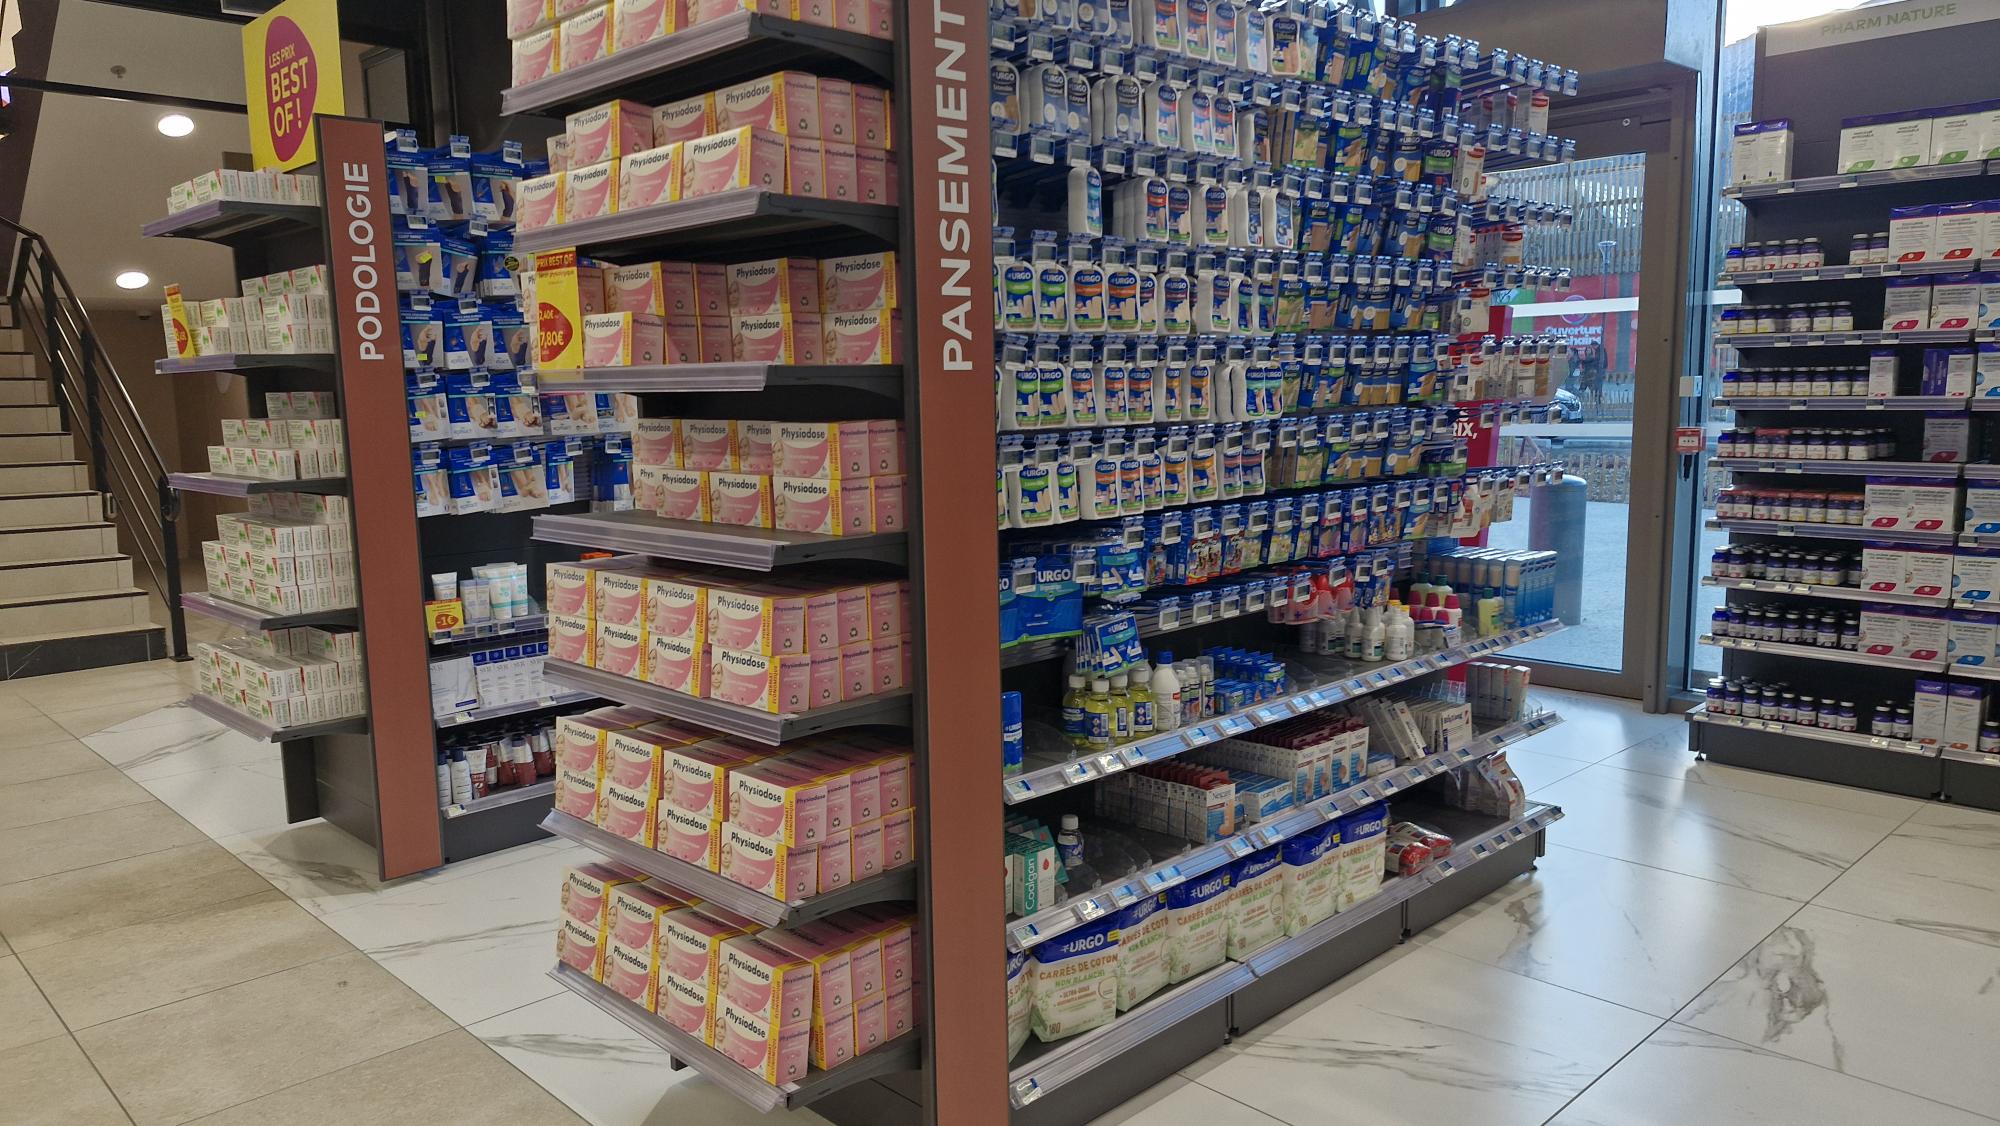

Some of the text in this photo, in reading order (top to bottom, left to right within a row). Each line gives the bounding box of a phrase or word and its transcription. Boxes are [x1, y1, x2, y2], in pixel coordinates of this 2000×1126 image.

[1820, 3, 1959, 36] PHARM NATURE
[269, 43, 296, 68] LES PRIX
[271, 56, 308, 104] BEST
[996, 72, 1015, 81] URGO
[726, 83, 770, 105] Physiodose
[274, 102, 293, 137] OF
[574, 110, 608, 128] Physiodose
[661, 102, 702, 121] Physiodose
[693, 136, 736, 155] Physiodose
[1433, 148, 1451, 158] URGO
[630, 150, 670, 169] Physiodose
[572, 166, 608, 183] Physiodose
[524, 178, 556, 194] Physiodose
[934, 0, 973, 371] PANSEMENT
[1152, 185, 1166, 195] URGO
[1210, 190, 1225, 200] URGO
[1437, 226, 1453, 235] URGO
[343, 162, 384, 360] PODOLOGIE
[537, 254, 574, 268] PRIX BEST OF
[835, 258, 881, 274] Physiodose
[614, 270, 650, 283] Physiodose
[736, 264, 776, 279] Physiodose
[1011, 272, 1031, 280] URGO
[1046, 274, 1064, 282] URGO
[1082, 274, 1100, 282] URGO
[1116, 276, 1136, 285] URGO
[585, 317, 620, 330] Physiodose
[740, 318, 780, 331] Physiodose
[834, 314, 878, 328] Physiodose
[1545, 326, 1602, 335] Ouverture
[1021, 372, 1036, 380] URGO
[1041, 372, 1061, 380] URGO
[638, 422, 671, 432] Physiodose
[690, 424, 726, 435] Physiodose
[781, 428, 826, 440] Physiodose
[1026, 468, 1046, 477] URGO
[1100, 463, 1116, 472] URGO
[1126, 461, 1139, 470] URGO
[662, 474, 698, 486] Physiodose
[718, 478, 758, 490] Physiodose
[784, 482, 827, 495] Physiodose
[554, 568, 585, 584] Physiodose
[1038, 568, 1071, 582] URGO
[604, 576, 640, 592] Physiodose
[656, 586, 694, 602] Physiodose
[718, 596, 760, 612] Physiodose
[438, 616, 454, 626] -1€
[554, 616, 586, 632] Physiodose
[1110, 621, 1128, 633] URGO
[604, 626, 638, 643] Physiodose
[656, 638, 691, 656] Physiodose
[722, 651, 766, 670] Physiodose
[563, 724, 596, 742] Physiodose
[615, 738, 650, 758] Physiodose
[672, 759, 712, 780] Physiodose
[563, 770, 596, 790] Physiodose
[608, 787, 646, 808] Physiodose
[740, 780, 782, 803] Physiodose
[666, 808, 708, 831] Physiodose
[1360, 820, 1381, 835] URGO
[731, 832, 774, 856] Physiodose
[569, 873, 601, 898] Physiodose
[1025, 858, 1037, 910] Coalgan
[1196, 879, 1222, 898] URGO
[617, 896, 652, 920] Physiodose
[564, 920, 596, 944] Physiodose
[668, 925, 706, 950] Physiodose
[1070, 934, 1104, 953] URGO
[613, 946, 648, 972] Physiodose
[728, 952, 770, 982] Physiodose
[1078, 959, 1090, 971] DE
[1090, 954, 1118, 967] COTON
[667, 976, 704, 1004] Physiodose
[726, 1007, 766, 1038] Physiodose
